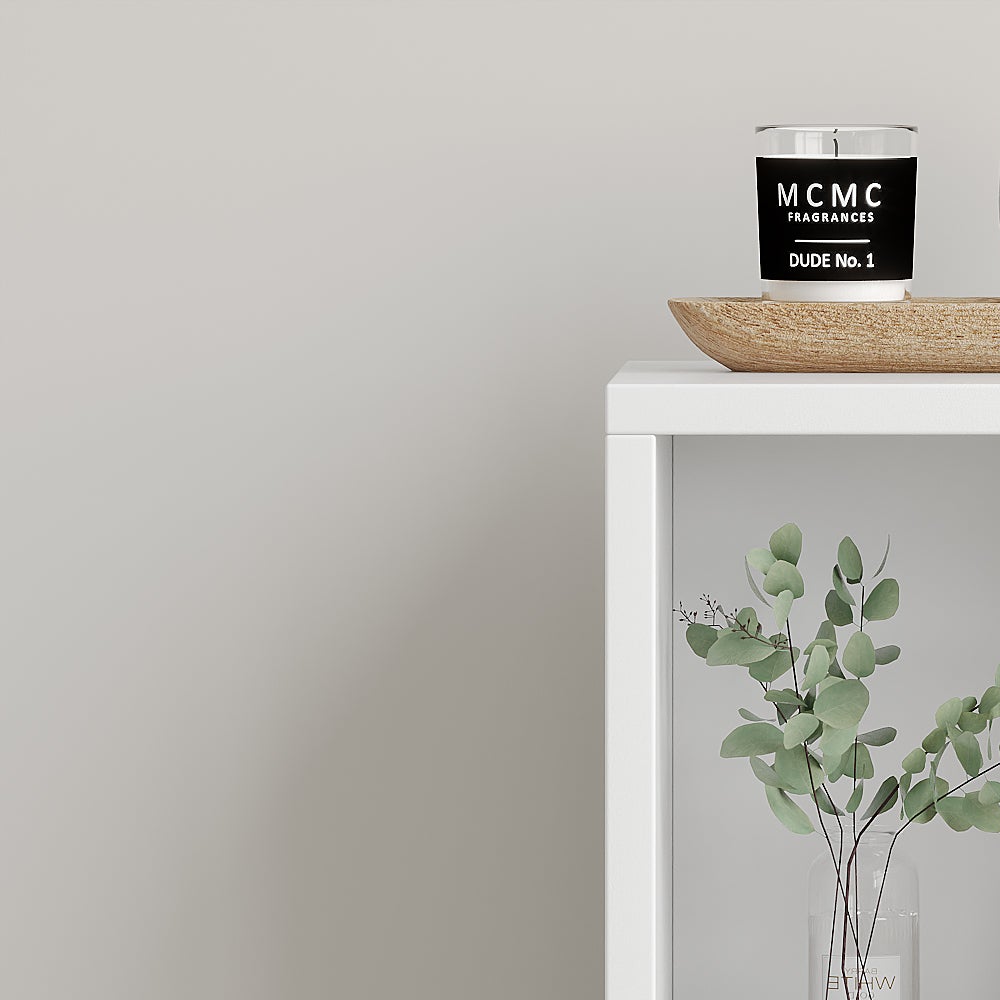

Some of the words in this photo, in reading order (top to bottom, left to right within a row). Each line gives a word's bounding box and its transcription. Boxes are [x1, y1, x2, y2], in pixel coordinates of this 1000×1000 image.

[777, 183, 882, 208] MCMC
[788, 211, 875, 223] FRAGRANCES
[789, 253, 831, 267] DUDE
[835, 253, 862, 268] No.
[866, 252, 875, 267] 1
